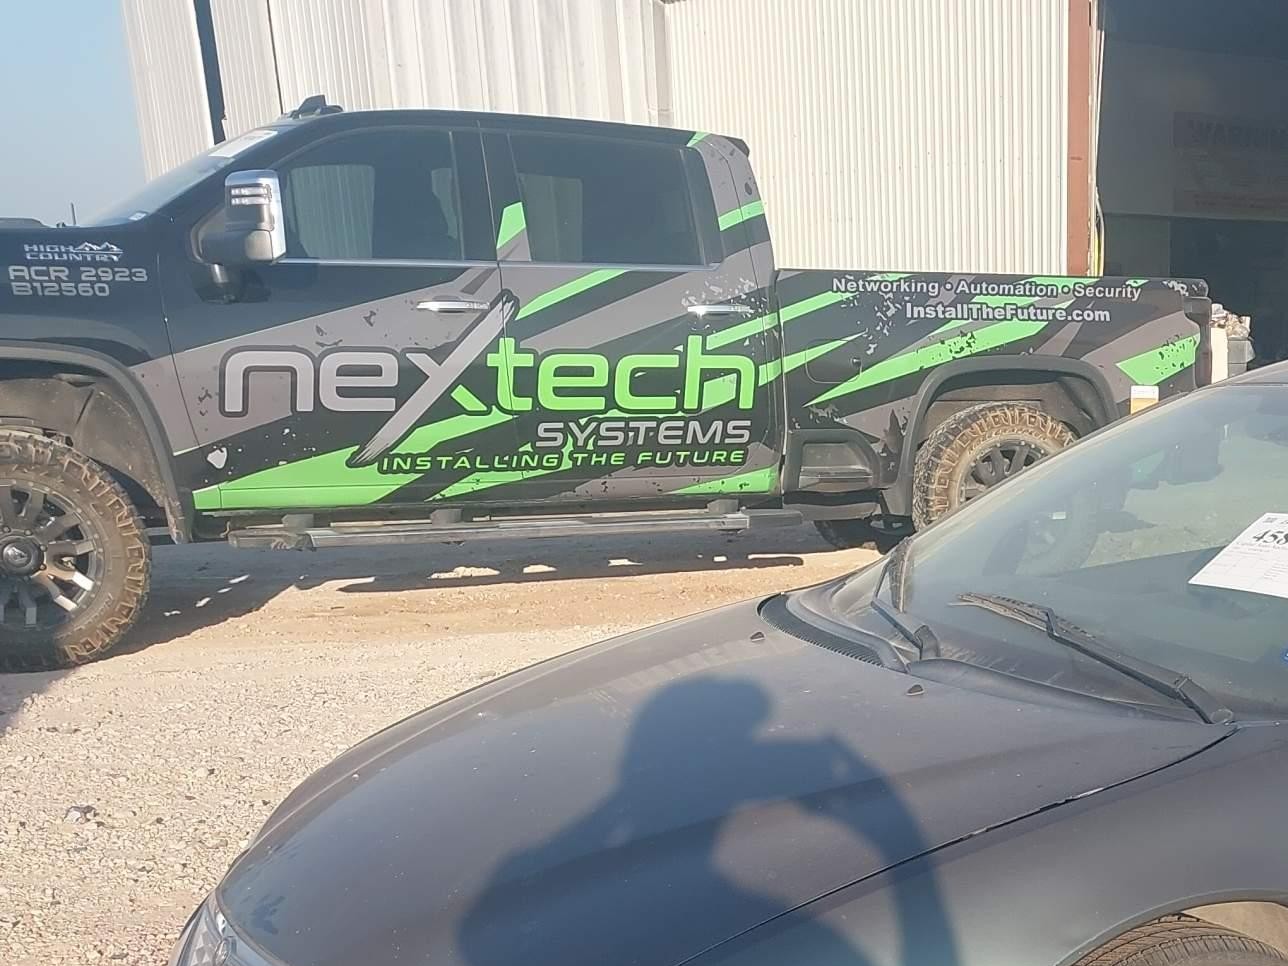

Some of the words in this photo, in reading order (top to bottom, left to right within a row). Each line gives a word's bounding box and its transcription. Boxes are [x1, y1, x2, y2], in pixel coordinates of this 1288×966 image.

[24, 244, 77, 252] HIGH
[26, 252, 121, 261] COUNTRY
[8, 265, 70, 280] ACR
[80, 266, 148, 282] 2923
[11, 282, 110, 296] B12560
[832, 278, 939, 295] Networking
[956, 280, 1057, 297] Automation
[1074, 284, 1142, 301] Security
[906, 302, 1110, 322] InstallTheFuture.com
[224, 295, 756, 463] nextech
[535, 420, 751, 447] SYSTEMS
[382, 454, 562, 471] INSTALLING
[573, 453, 627, 467] THE
[637, 450, 745, 466] FUTURE
